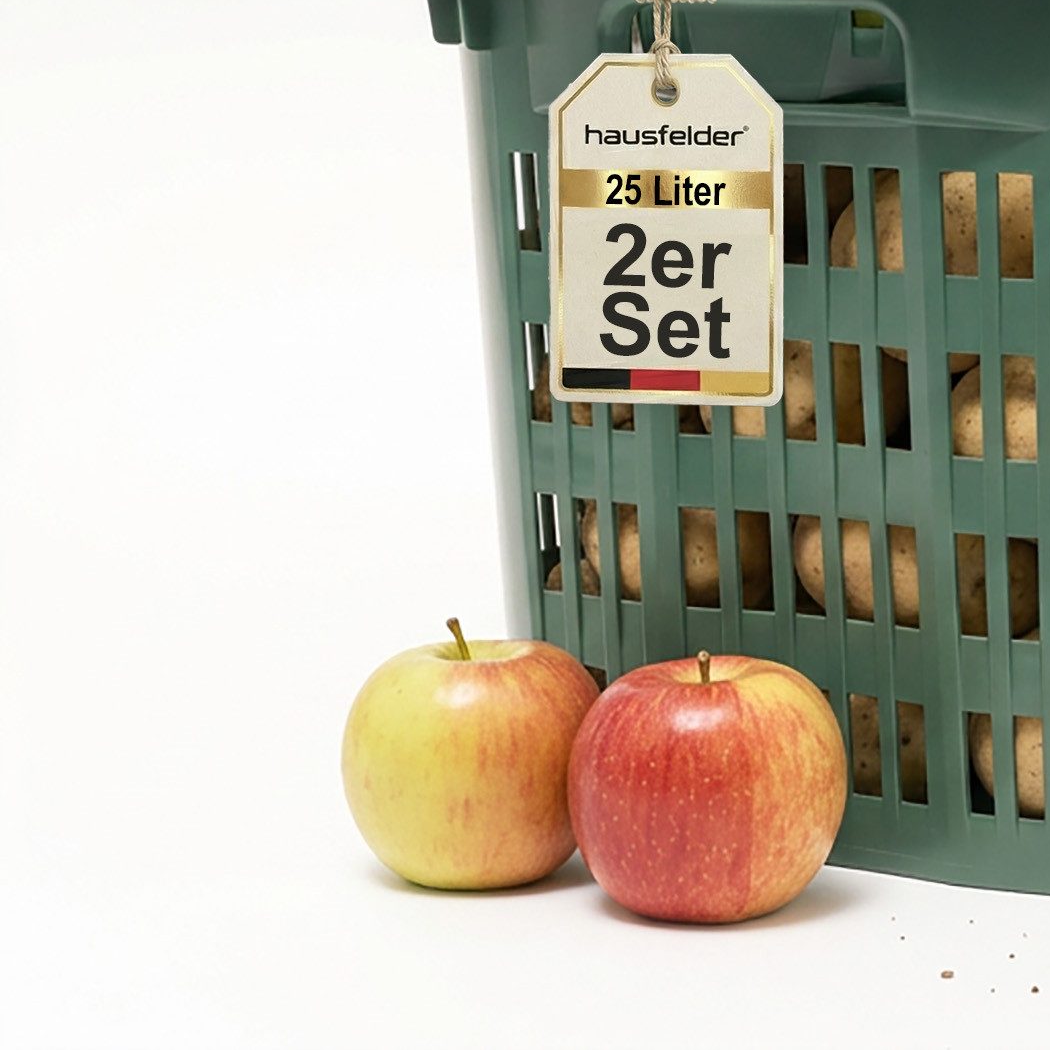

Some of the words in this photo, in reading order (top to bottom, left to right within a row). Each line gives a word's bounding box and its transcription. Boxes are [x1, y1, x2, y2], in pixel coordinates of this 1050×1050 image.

[606, 174, 642, 205] 25
[654, 175, 727, 206] Liter
[602, 222, 733, 289] 2er
[599, 291, 731, 359] Set
